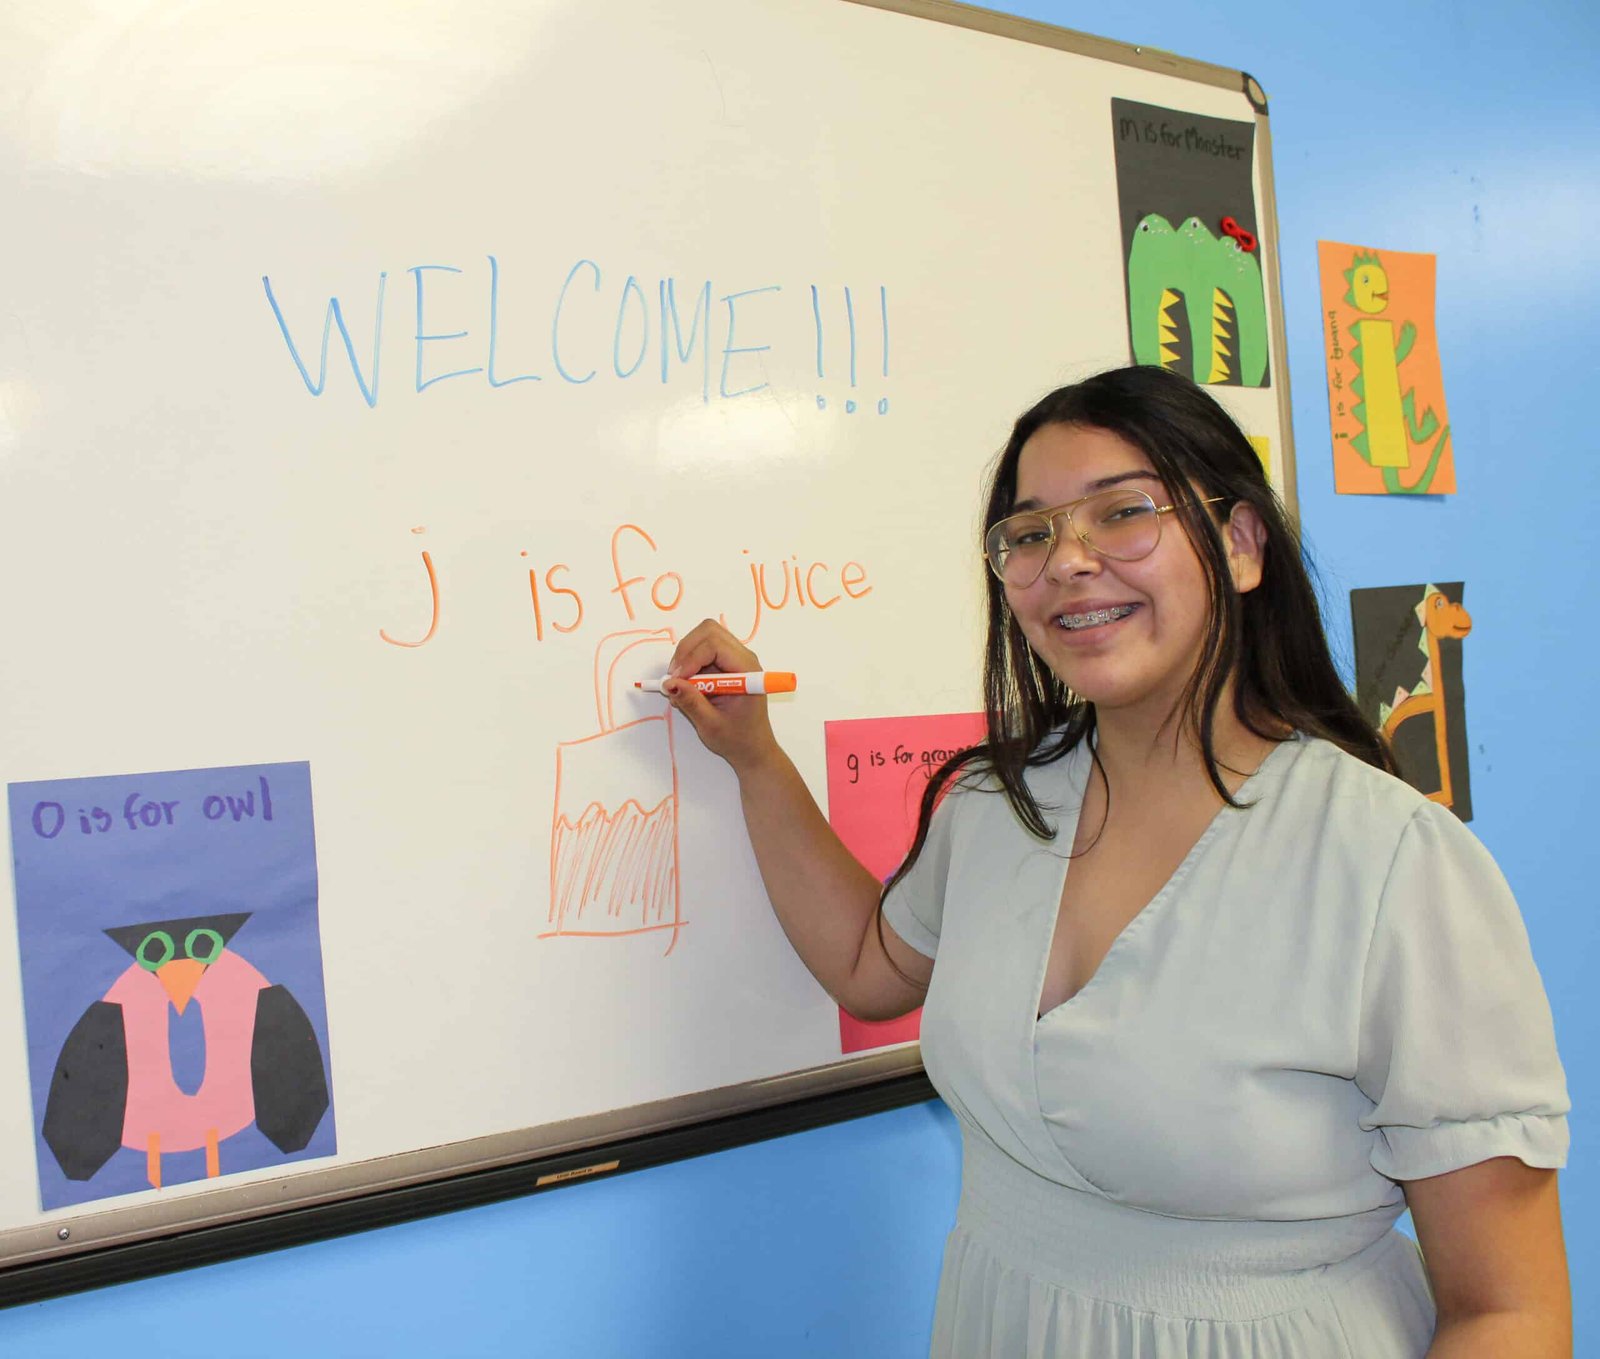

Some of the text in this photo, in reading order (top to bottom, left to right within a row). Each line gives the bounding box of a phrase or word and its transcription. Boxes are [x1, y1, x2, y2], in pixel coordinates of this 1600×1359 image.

[1160, 122, 1183, 148] for
[1328, 310, 1344, 360] iguana
[1332, 366, 1343, 392] for
[1337, 401, 1346, 417] is
[519, 549, 585, 642] is
[610, 524, 685, 621] fo
[720, 548, 873, 645] juice
[847, 753, 859, 784] g
[870, 750, 885, 767] is
[893, 744, 914, 764] for
[77, 806, 113, 835] is
[123, 792, 180, 831] for
[202, 775, 272, 822] owl
